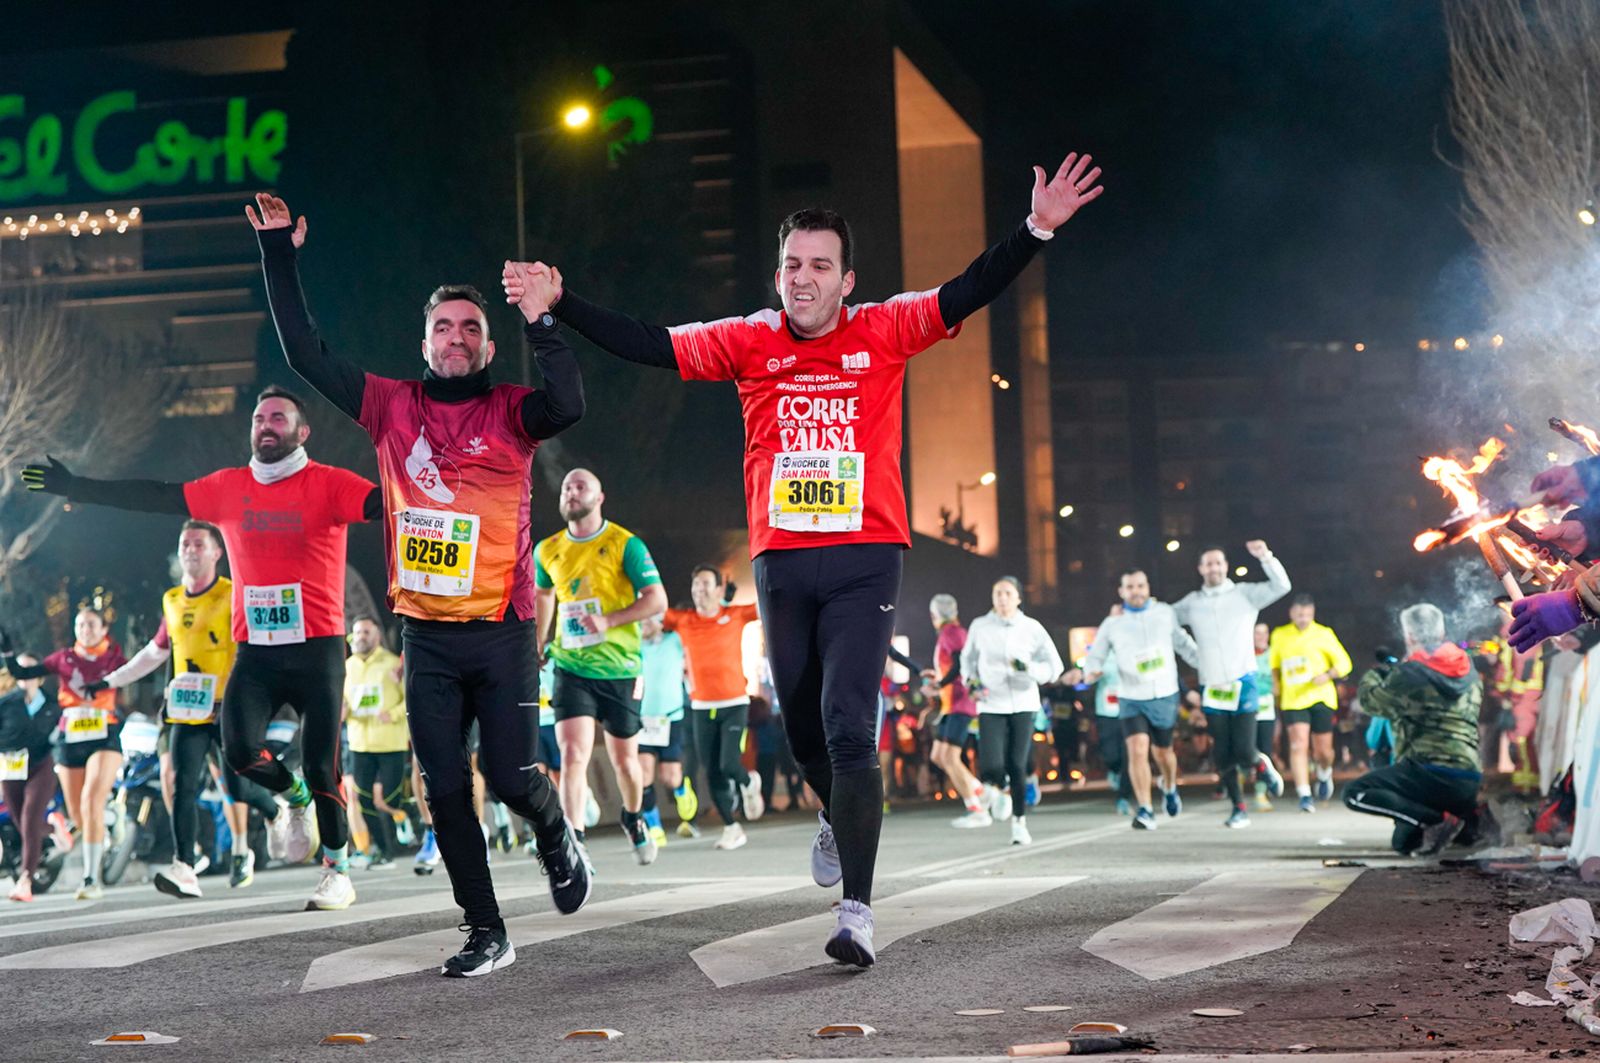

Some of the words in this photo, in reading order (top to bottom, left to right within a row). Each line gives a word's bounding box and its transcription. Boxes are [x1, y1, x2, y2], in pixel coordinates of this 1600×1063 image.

[73, 90, 288, 193] Corte
[794, 374, 815, 382] CORRE
[807, 384, 817, 392] EN
[777, 395, 860, 426] CORRE
[780, 426, 857, 453] CAUSA
[791, 459, 818, 468] NOCHE
[819, 459, 830, 469] DE
[415, 467, 438, 490] 43
[781, 470, 798, 479] SAN
[788, 480, 846, 506] 3061
[433, 520, 445, 529] DE
[406, 537, 459, 568] 6258
[254, 606, 290, 625] 3248
[176, 689, 206, 705] 9052
